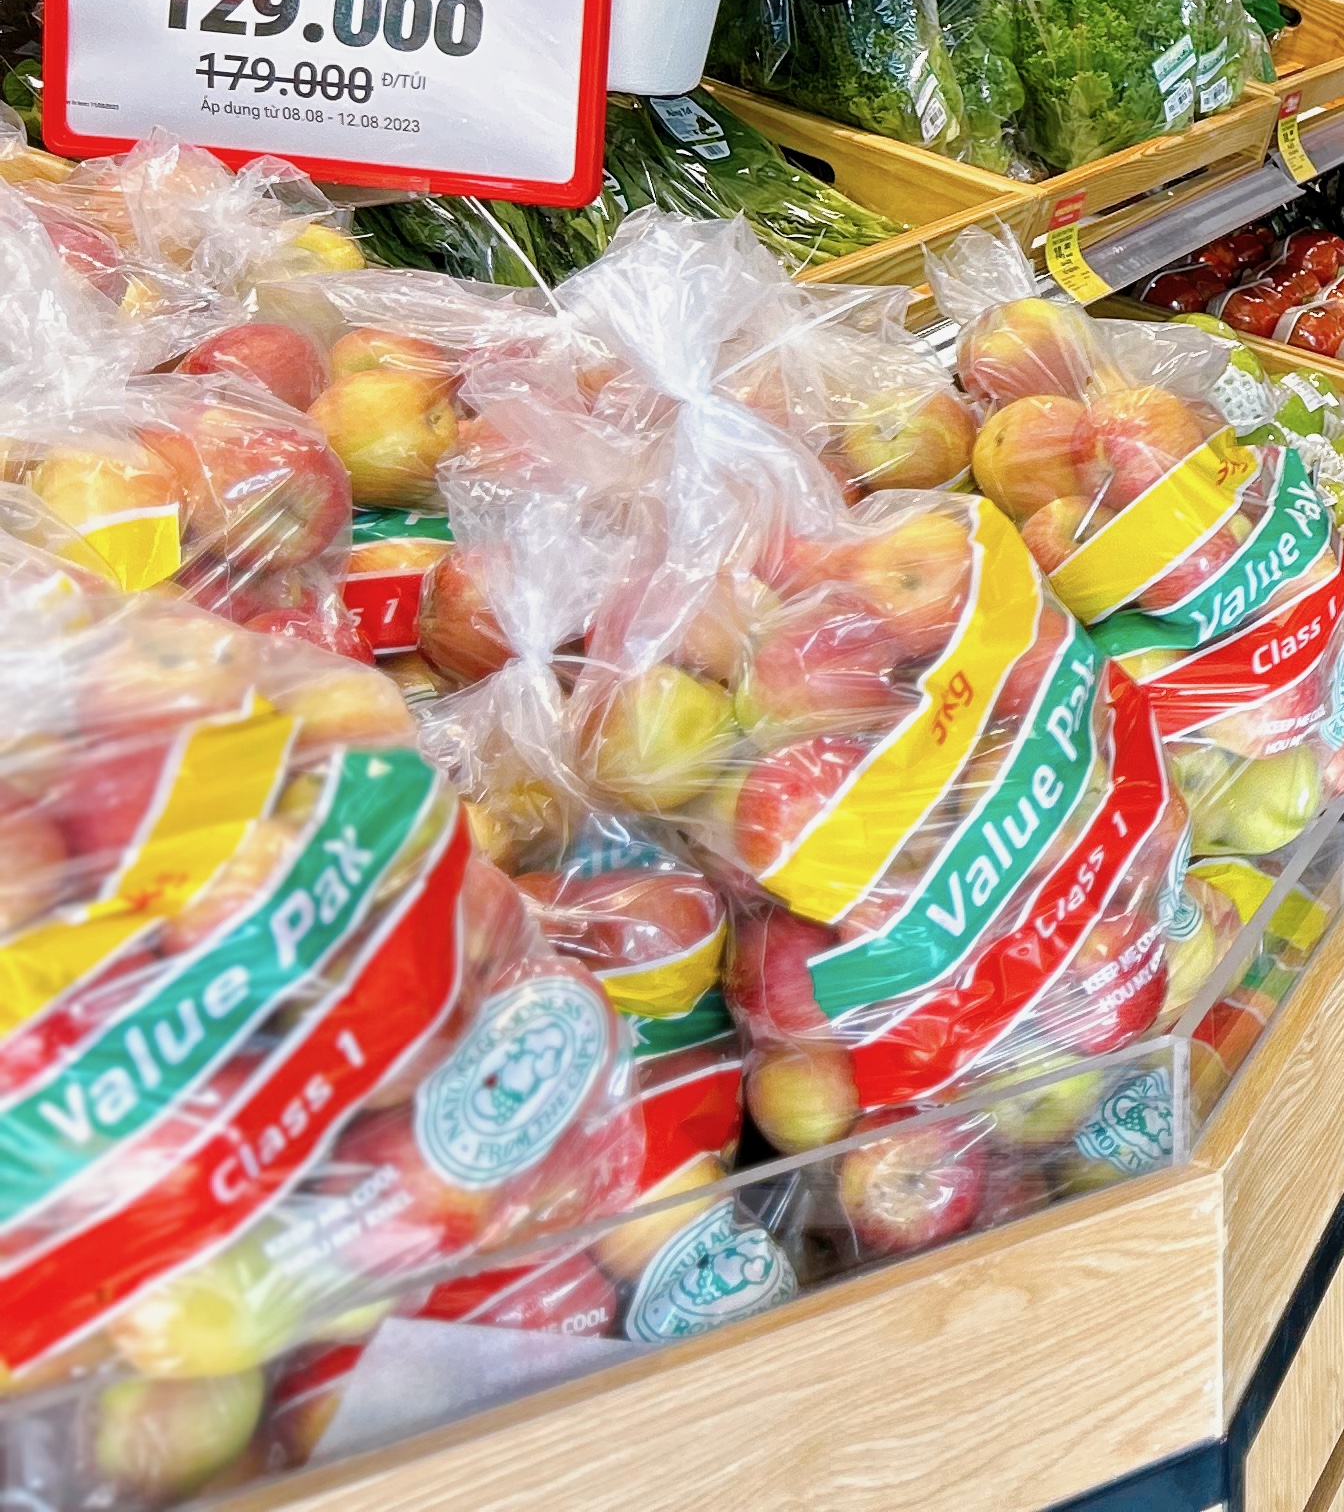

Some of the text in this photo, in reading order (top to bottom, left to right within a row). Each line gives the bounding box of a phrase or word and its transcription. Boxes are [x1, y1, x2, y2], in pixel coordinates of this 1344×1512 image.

[196, 51, 428, 105] 179.000 Đ/TÚI
[201, 94, 220, 116] Áp
[264, 105, 279, 119] từ
[283, 106, 324, 124] 08.08
[338, 112, 421, 134] 12.08.2023
[1190, 532, 1300, 640] Value
[1252, 615, 1322, 675] Class
[926, 763, 1064, 937] Value
[1035, 809, 1129, 939] Class 1
[39, 824, 374, 1145] Value Pak
[208, 1029, 368, 1205] Class 1
[562, 1306, 609, 1336] COOL
